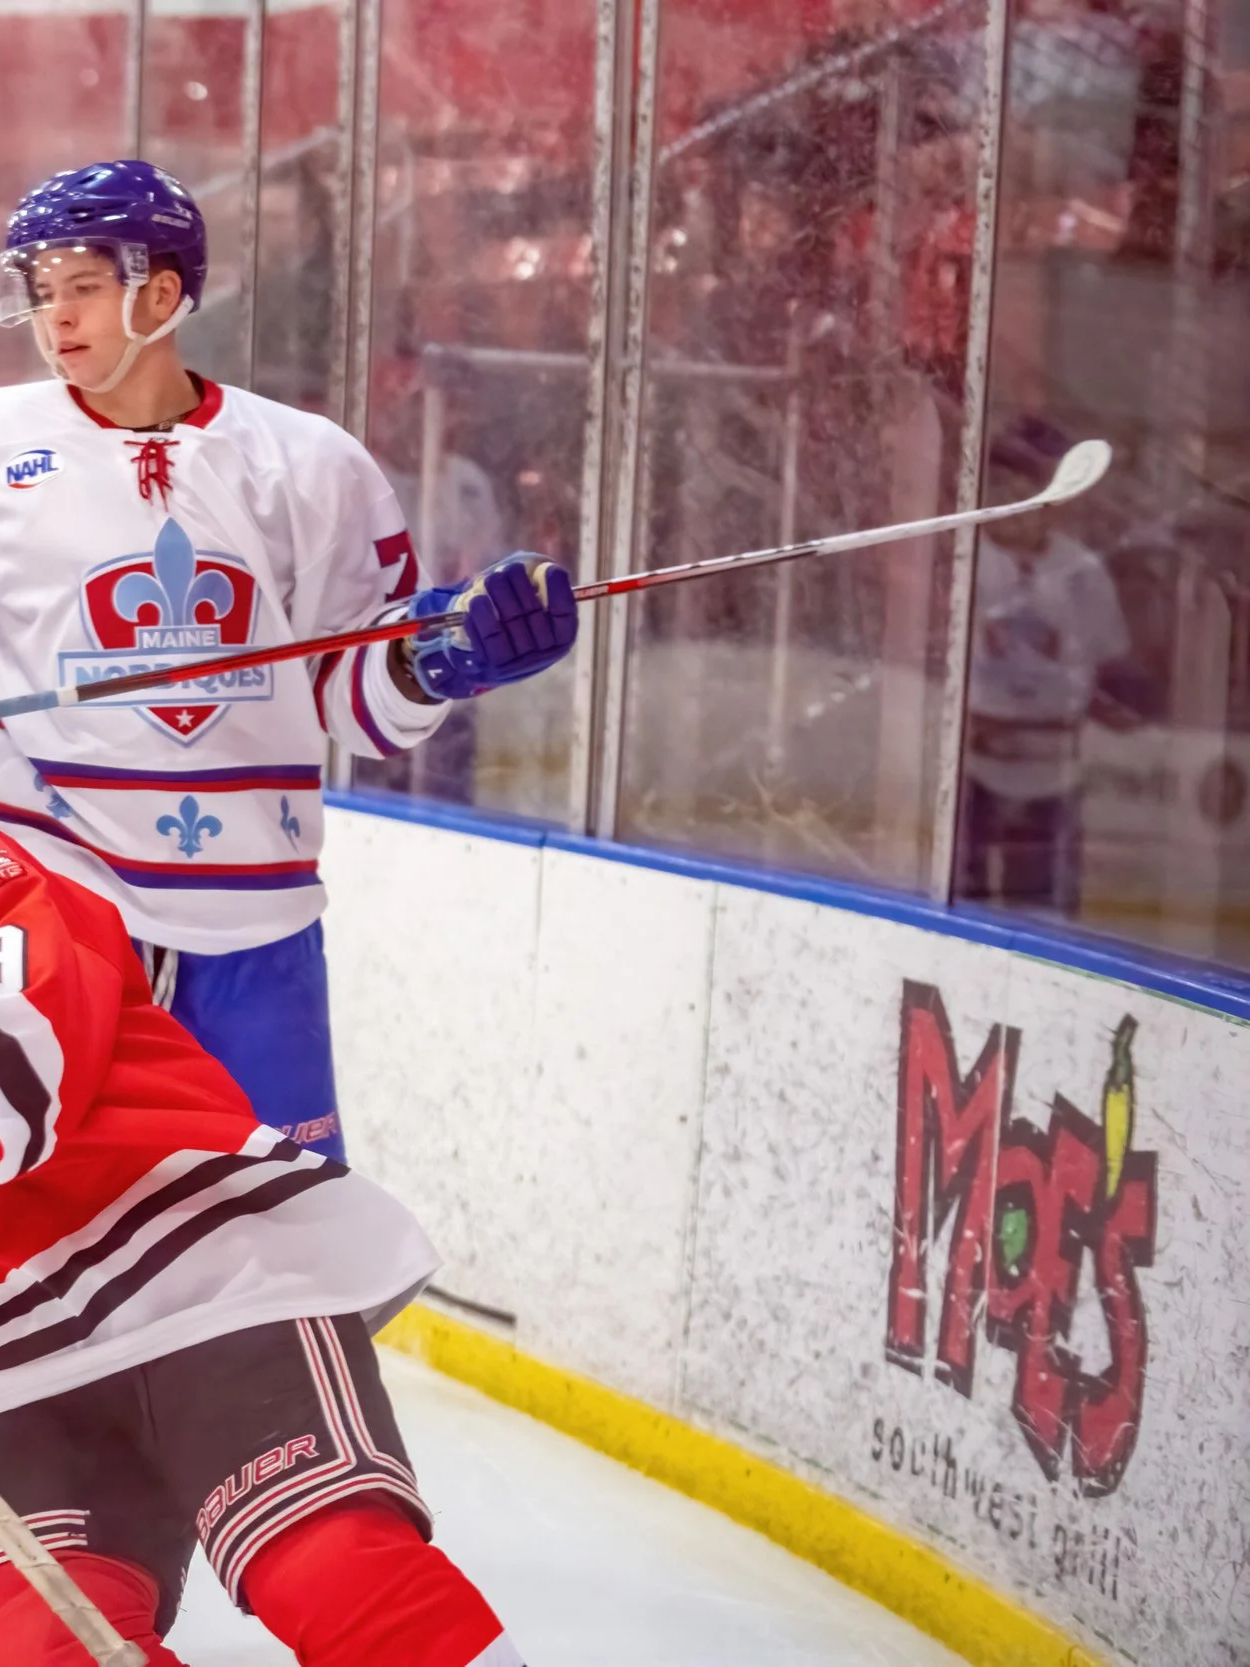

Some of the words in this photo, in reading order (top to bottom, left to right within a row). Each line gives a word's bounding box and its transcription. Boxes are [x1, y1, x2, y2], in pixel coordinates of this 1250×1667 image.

[6, 455, 60, 485] NAHL
[142, 629, 217, 650] MAINE
[196, 1434, 320, 1548] BAUER
